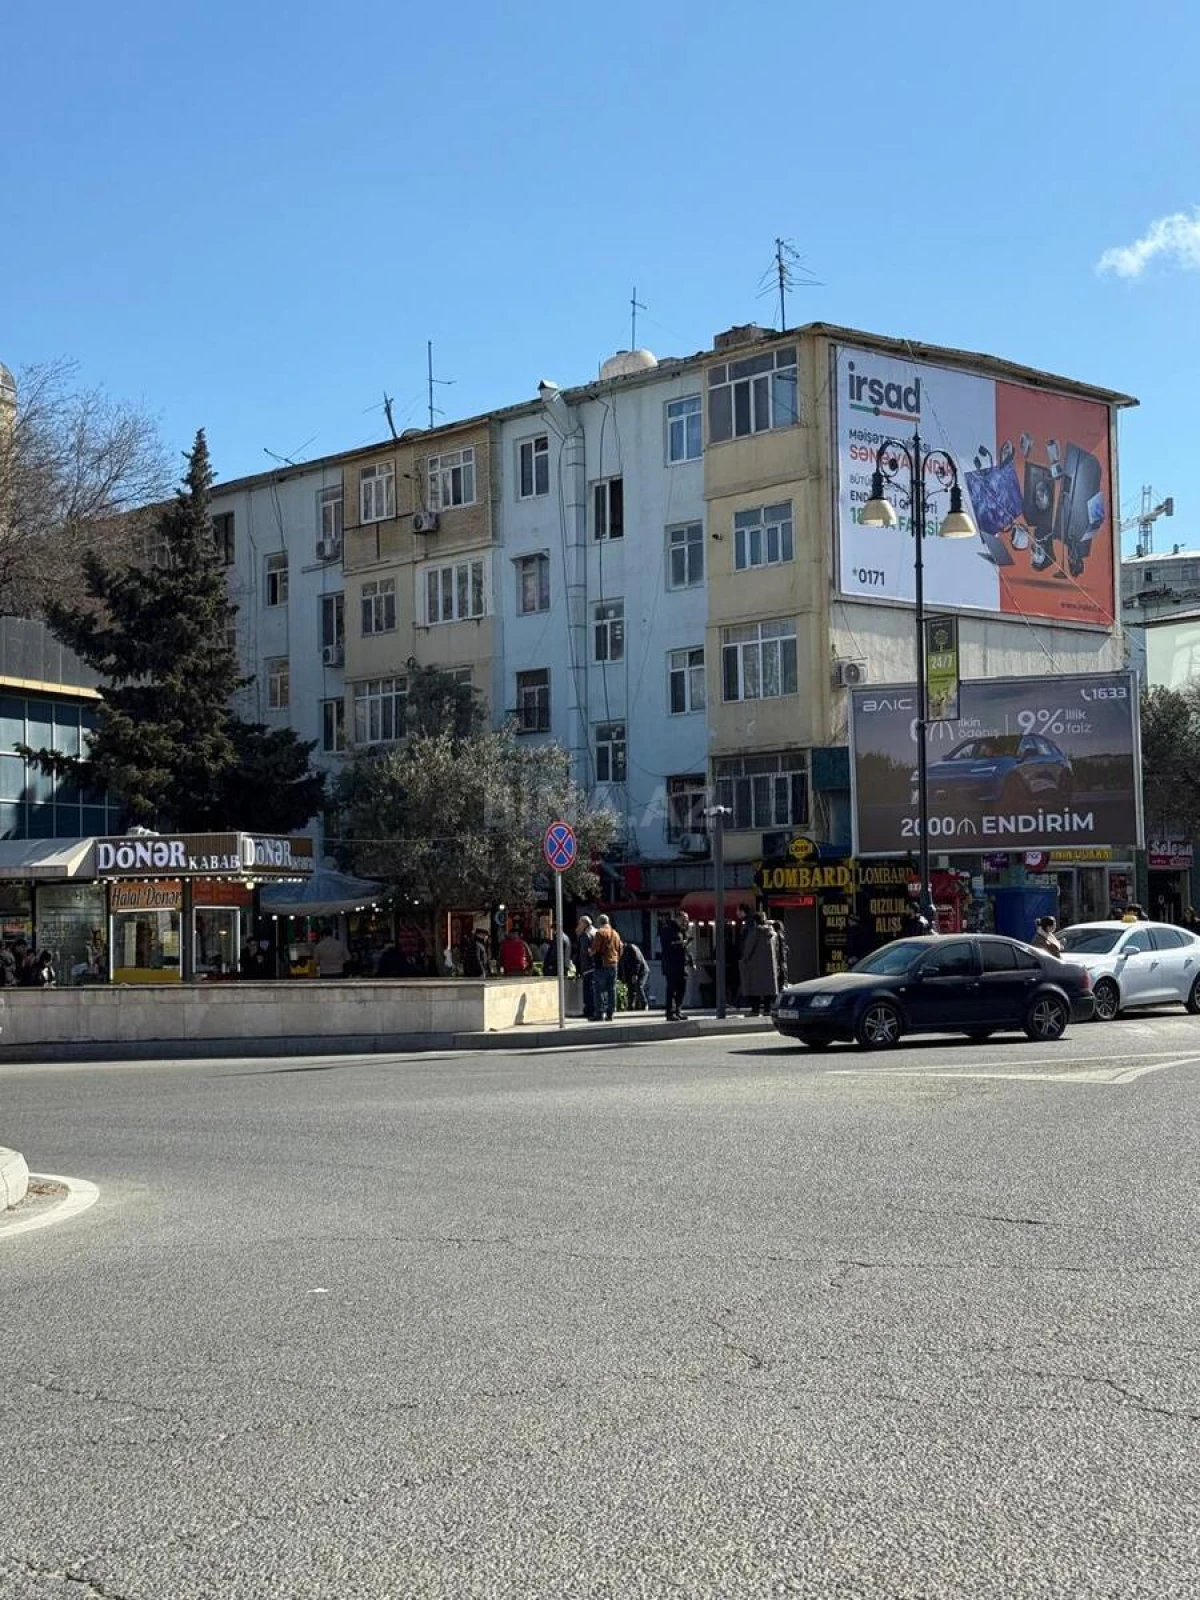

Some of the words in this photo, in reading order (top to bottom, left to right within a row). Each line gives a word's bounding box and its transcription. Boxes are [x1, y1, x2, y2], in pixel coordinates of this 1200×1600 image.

[1092, 687, 1127, 700] 1633
[982, 807, 1094, 834] ENDİRİM
[762, 866, 850, 889] LOMBARD
